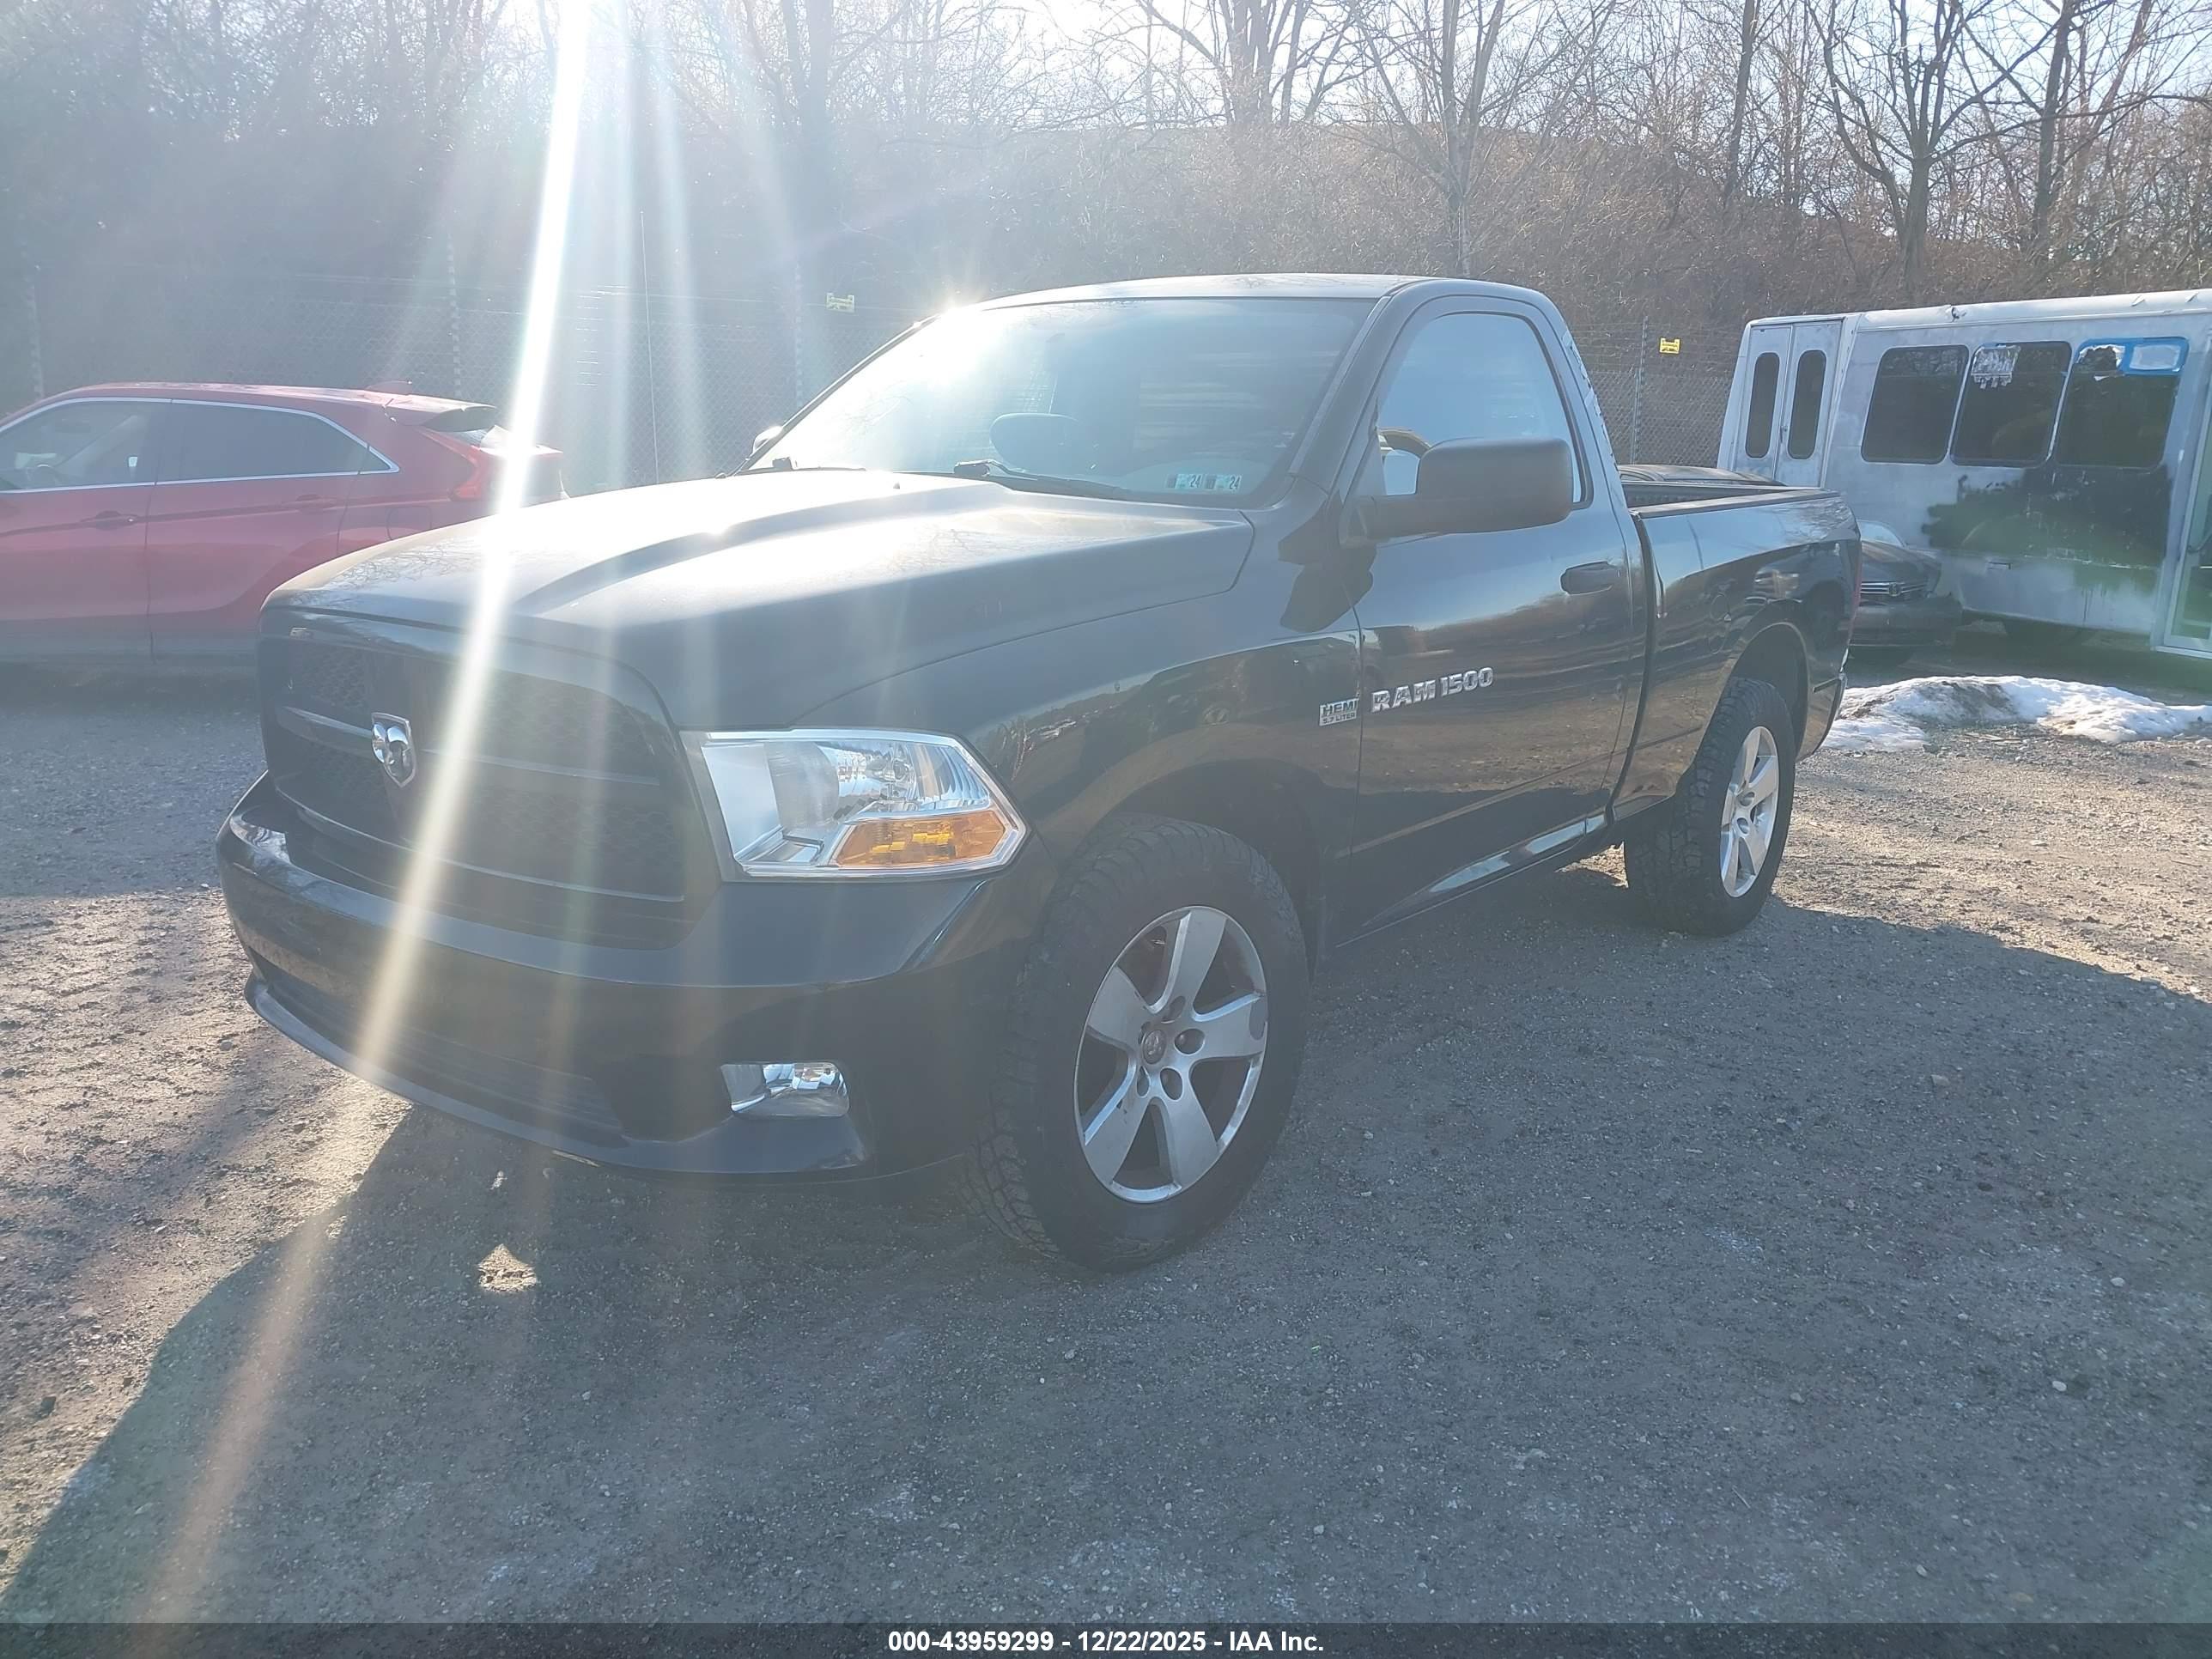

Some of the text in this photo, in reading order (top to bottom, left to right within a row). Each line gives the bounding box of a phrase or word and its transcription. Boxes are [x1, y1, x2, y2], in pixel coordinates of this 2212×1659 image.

[1190, 474, 1202, 489] 24
[1229, 475, 1241, 489] 24
[1371, 667, 1494, 713] RAM 1500
[1322, 699, 1358, 715] HEMI
[1322, 712, 1356, 725] 5.7 LITER
